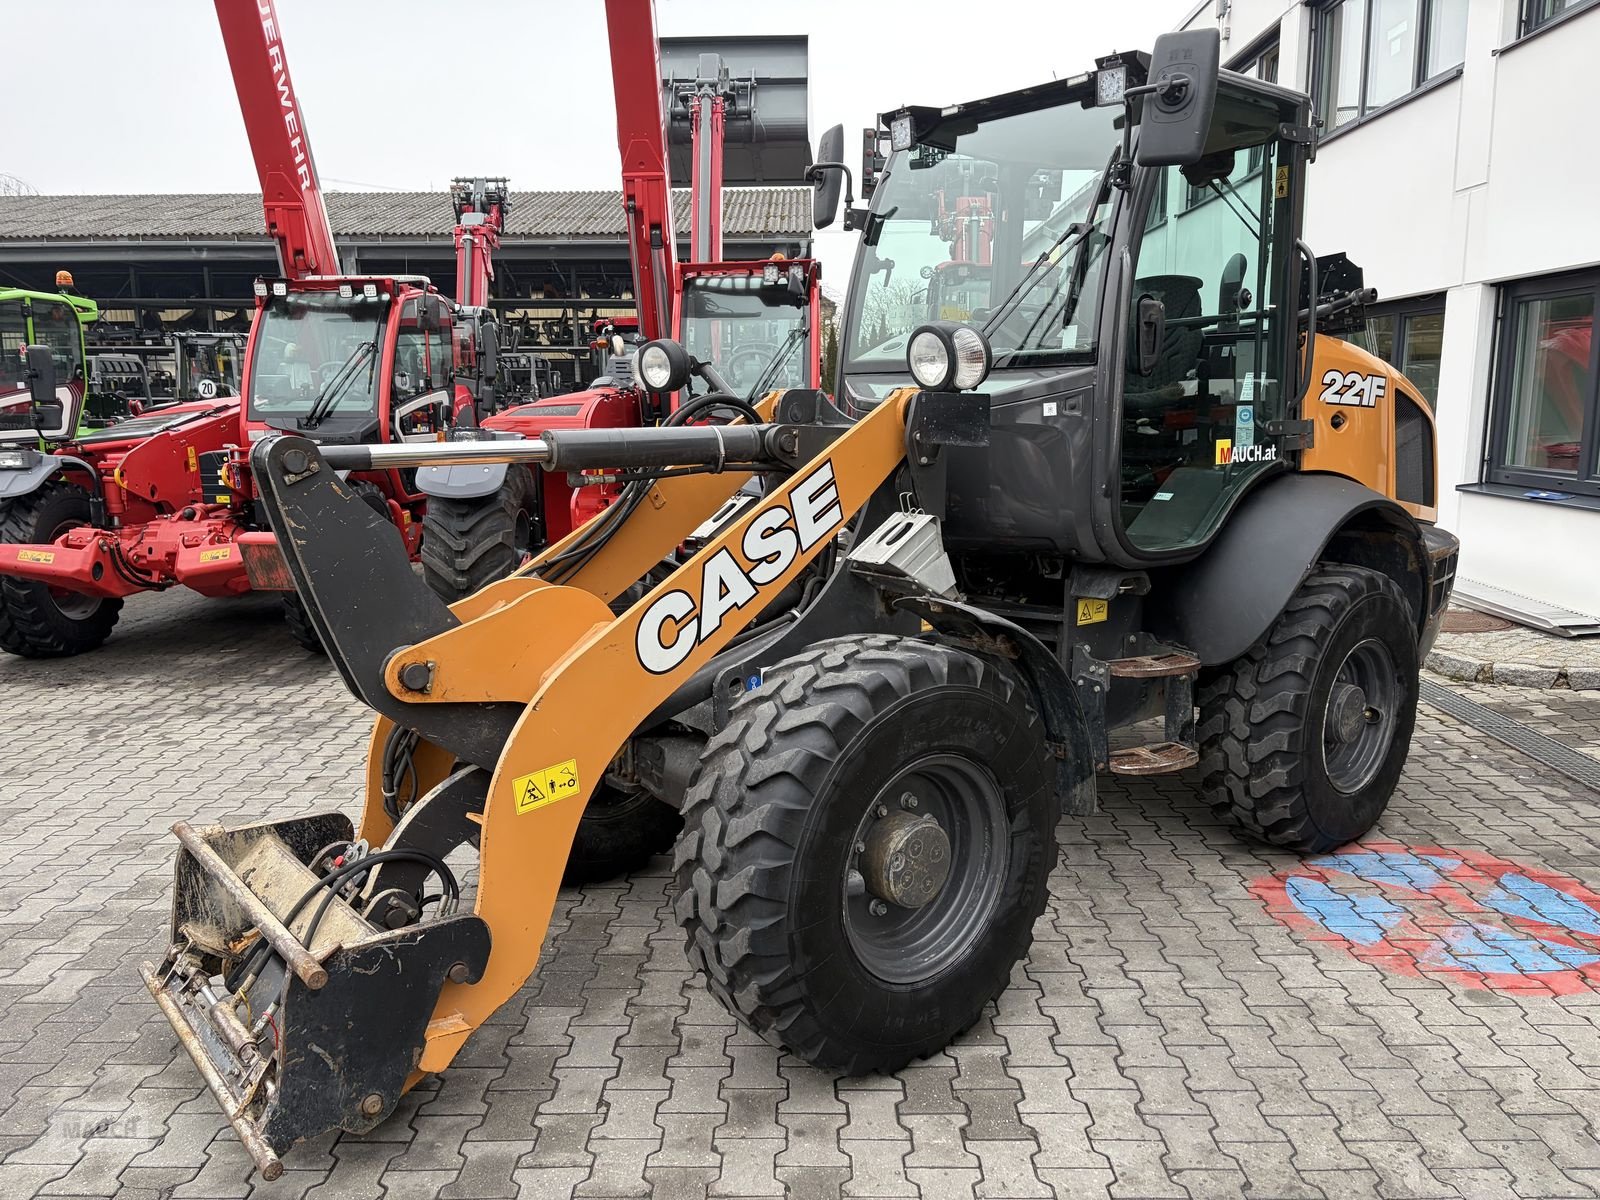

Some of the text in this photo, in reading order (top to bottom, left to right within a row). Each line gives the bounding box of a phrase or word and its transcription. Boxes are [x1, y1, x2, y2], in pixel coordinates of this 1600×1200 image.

[202, 383, 213, 395] 20
[1318, 369, 1387, 408] 221F
[1220, 444, 1277, 464] MAUCH.at
[635, 458, 843, 675] CASE
